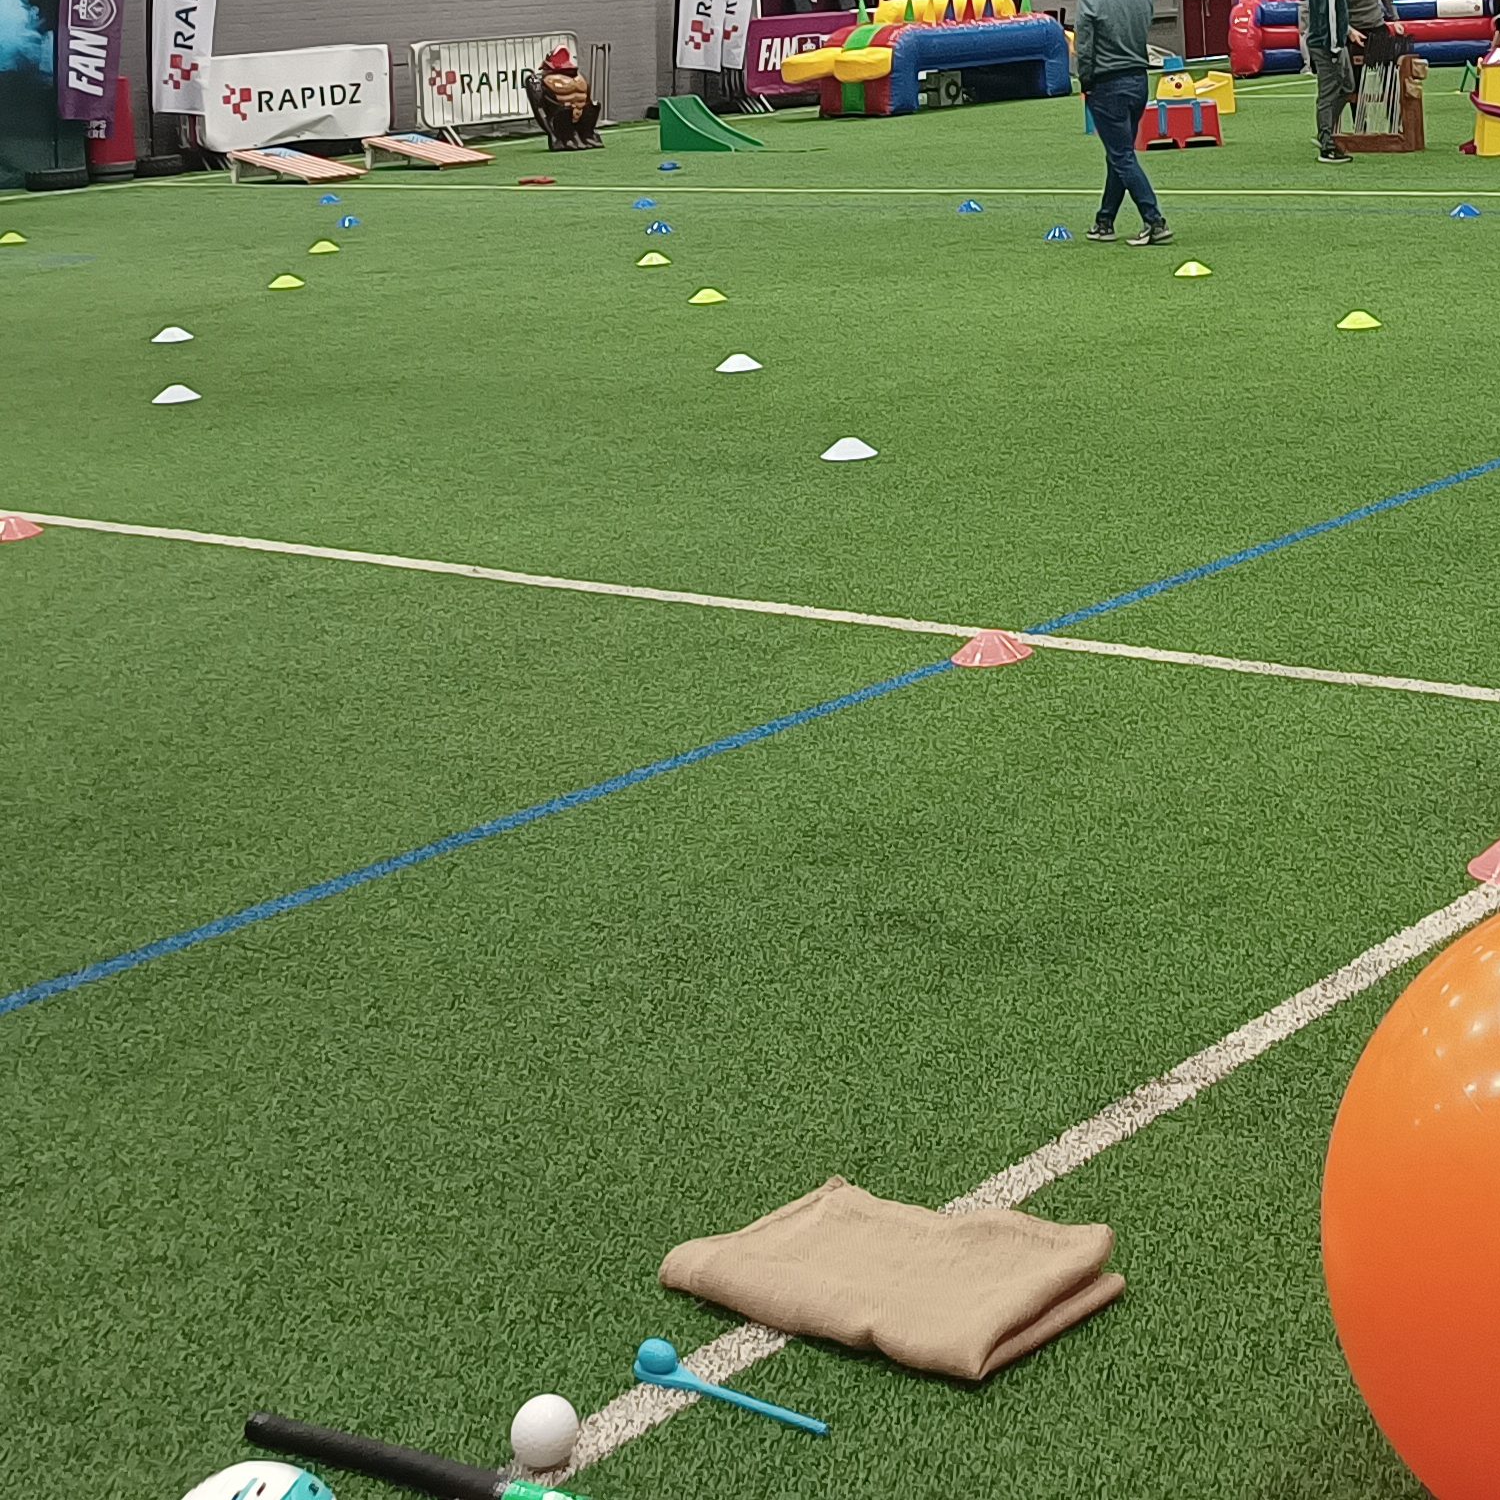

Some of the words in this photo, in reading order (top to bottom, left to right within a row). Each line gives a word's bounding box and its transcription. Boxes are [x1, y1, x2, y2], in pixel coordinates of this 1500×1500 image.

[68, 30, 109, 97] FAN
[460, 67, 536, 95] RAPID
[256, 82, 363, 113] RAPIDZ
